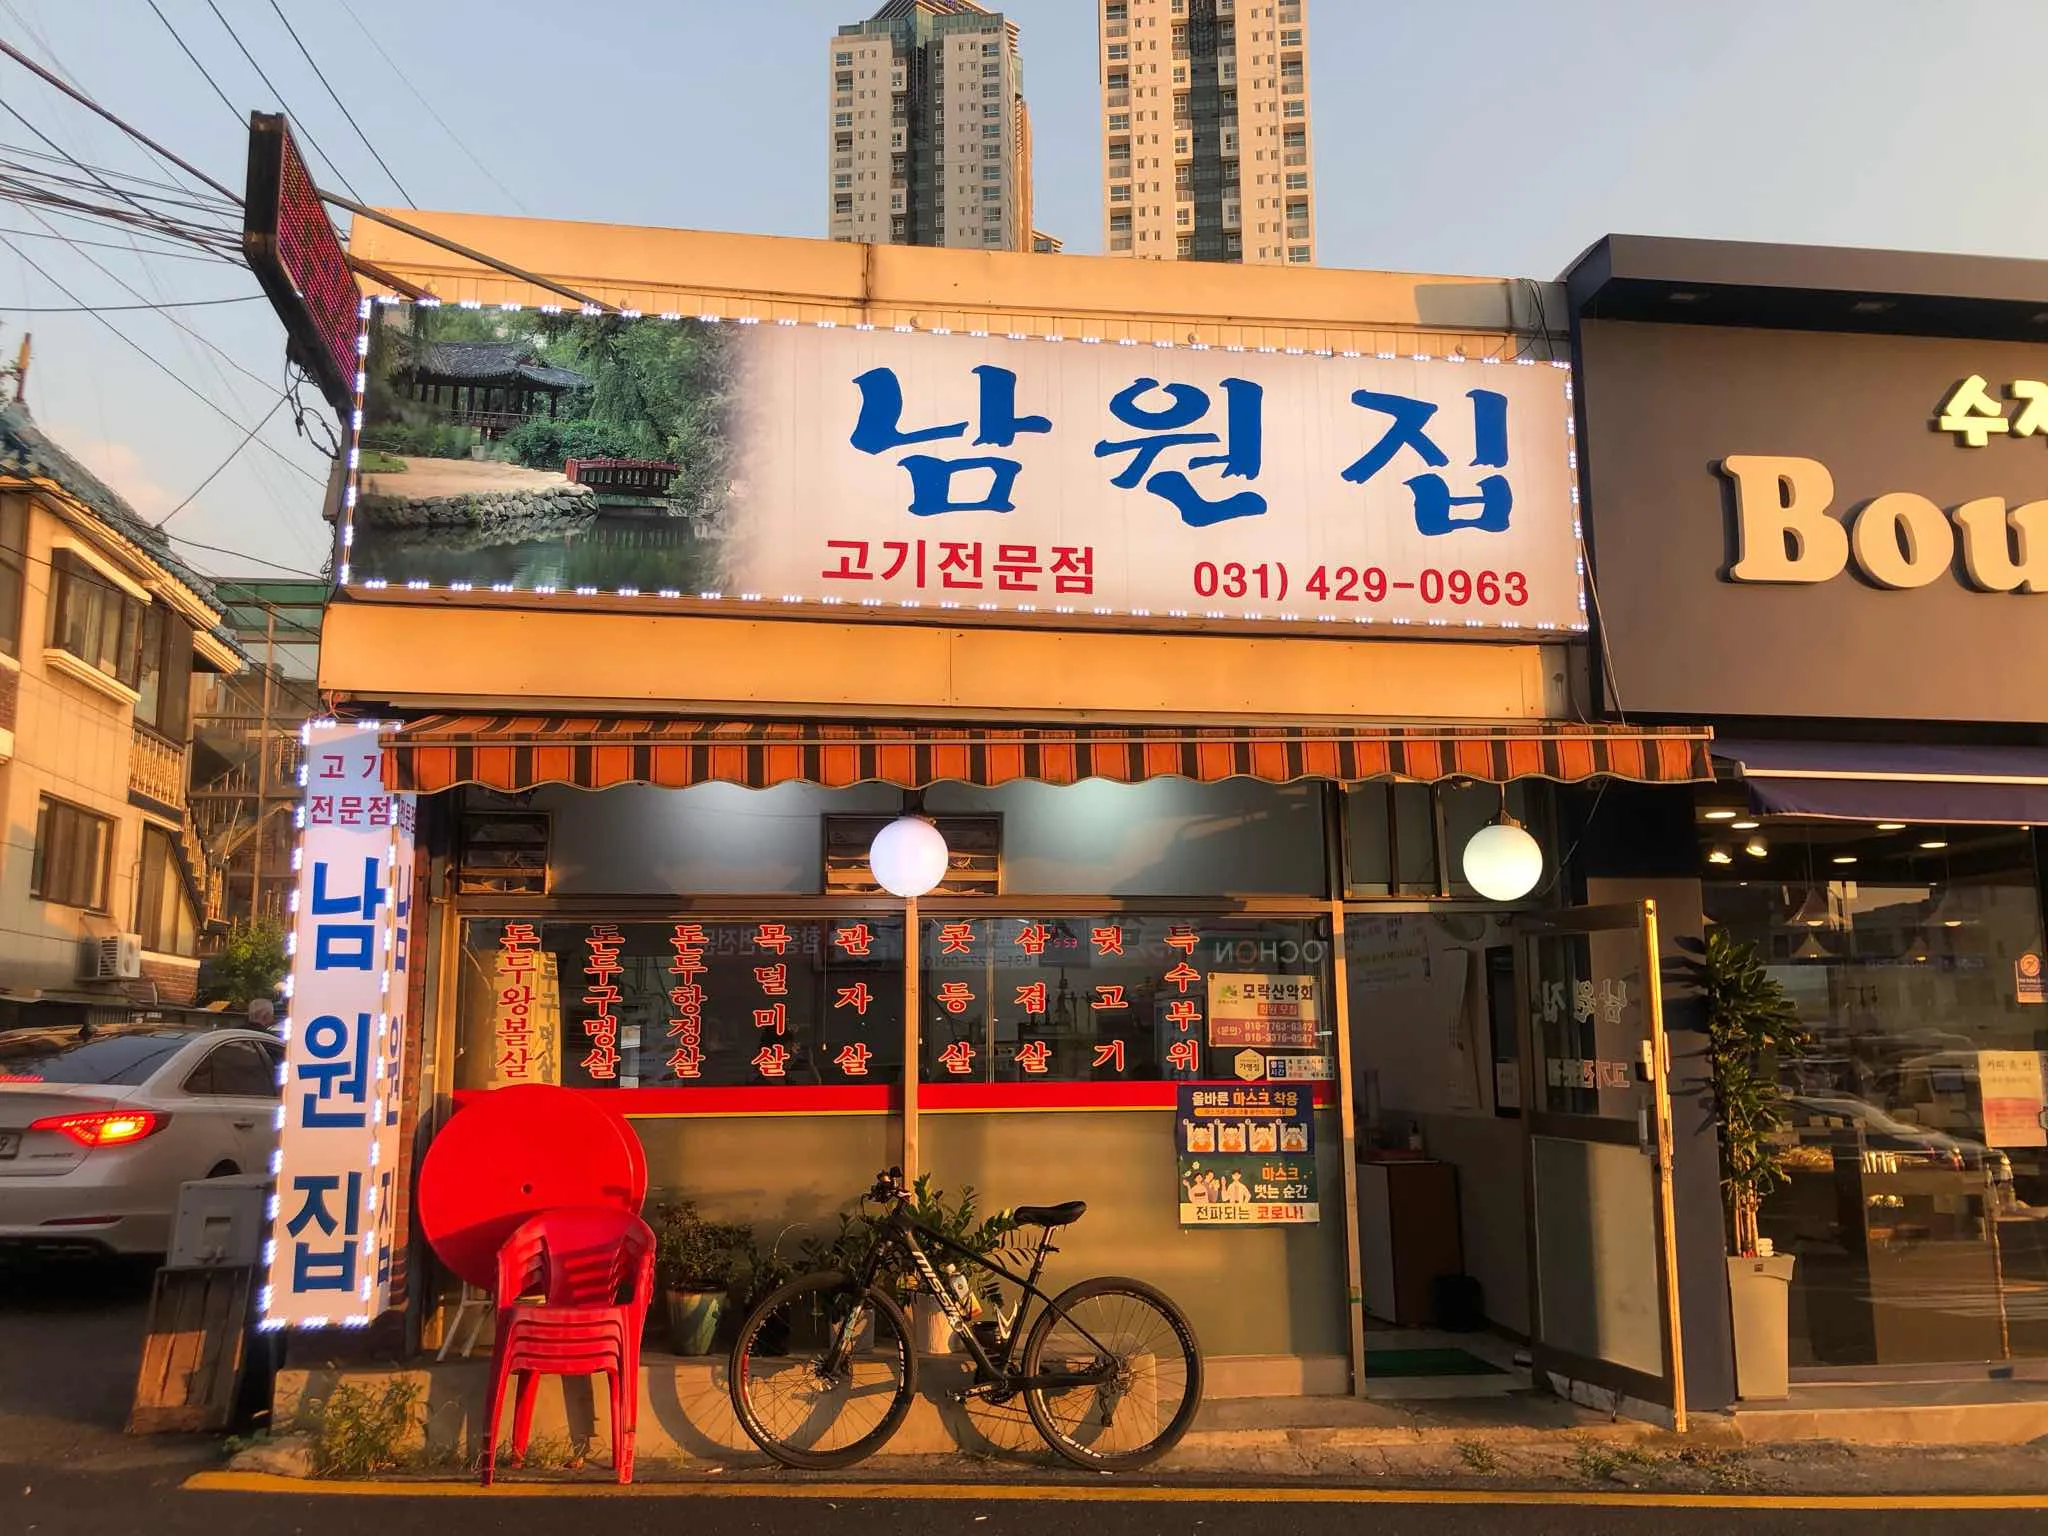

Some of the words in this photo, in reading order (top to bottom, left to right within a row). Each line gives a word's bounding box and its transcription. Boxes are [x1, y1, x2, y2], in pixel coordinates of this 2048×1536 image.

[851, 366, 1511, 534] 남원집
[823, 540, 1092, 594] 고기전문점
[1194, 561, 1288, 601] 031)
[1305, 566, 1528, 607] 429-0963
[310, 795, 392, 825] 전문점
[752, 923, 791, 1077] 목덜미살
[833, 923, 873, 1076] 관자살
[936, 923, 977, 1074] 콧등살
[1014, 923, 1053, 1074] 삼겹살
[1090, 924, 1128, 1073] 뒷고기
[1163, 924, 1202, 1073] 특수부위
[1243, 983, 1313, 1001] 모락산악회
[286, 856, 386, 1293] 남원집
[1192, 1091, 1230, 1106] 올바른
[1233, 1091, 1271, 1106] 마스크
[1274, 1091, 1298, 1106] 착용
[1196, 1206, 1250, 1221] 전파되는
[1256, 1206, 1304, 1220] 코로나!
[1254, 1184, 1279, 1199] 벗는
[1283, 1184, 1309, 1199] 순간
[1262, 1166, 1299, 1181] 마스크
